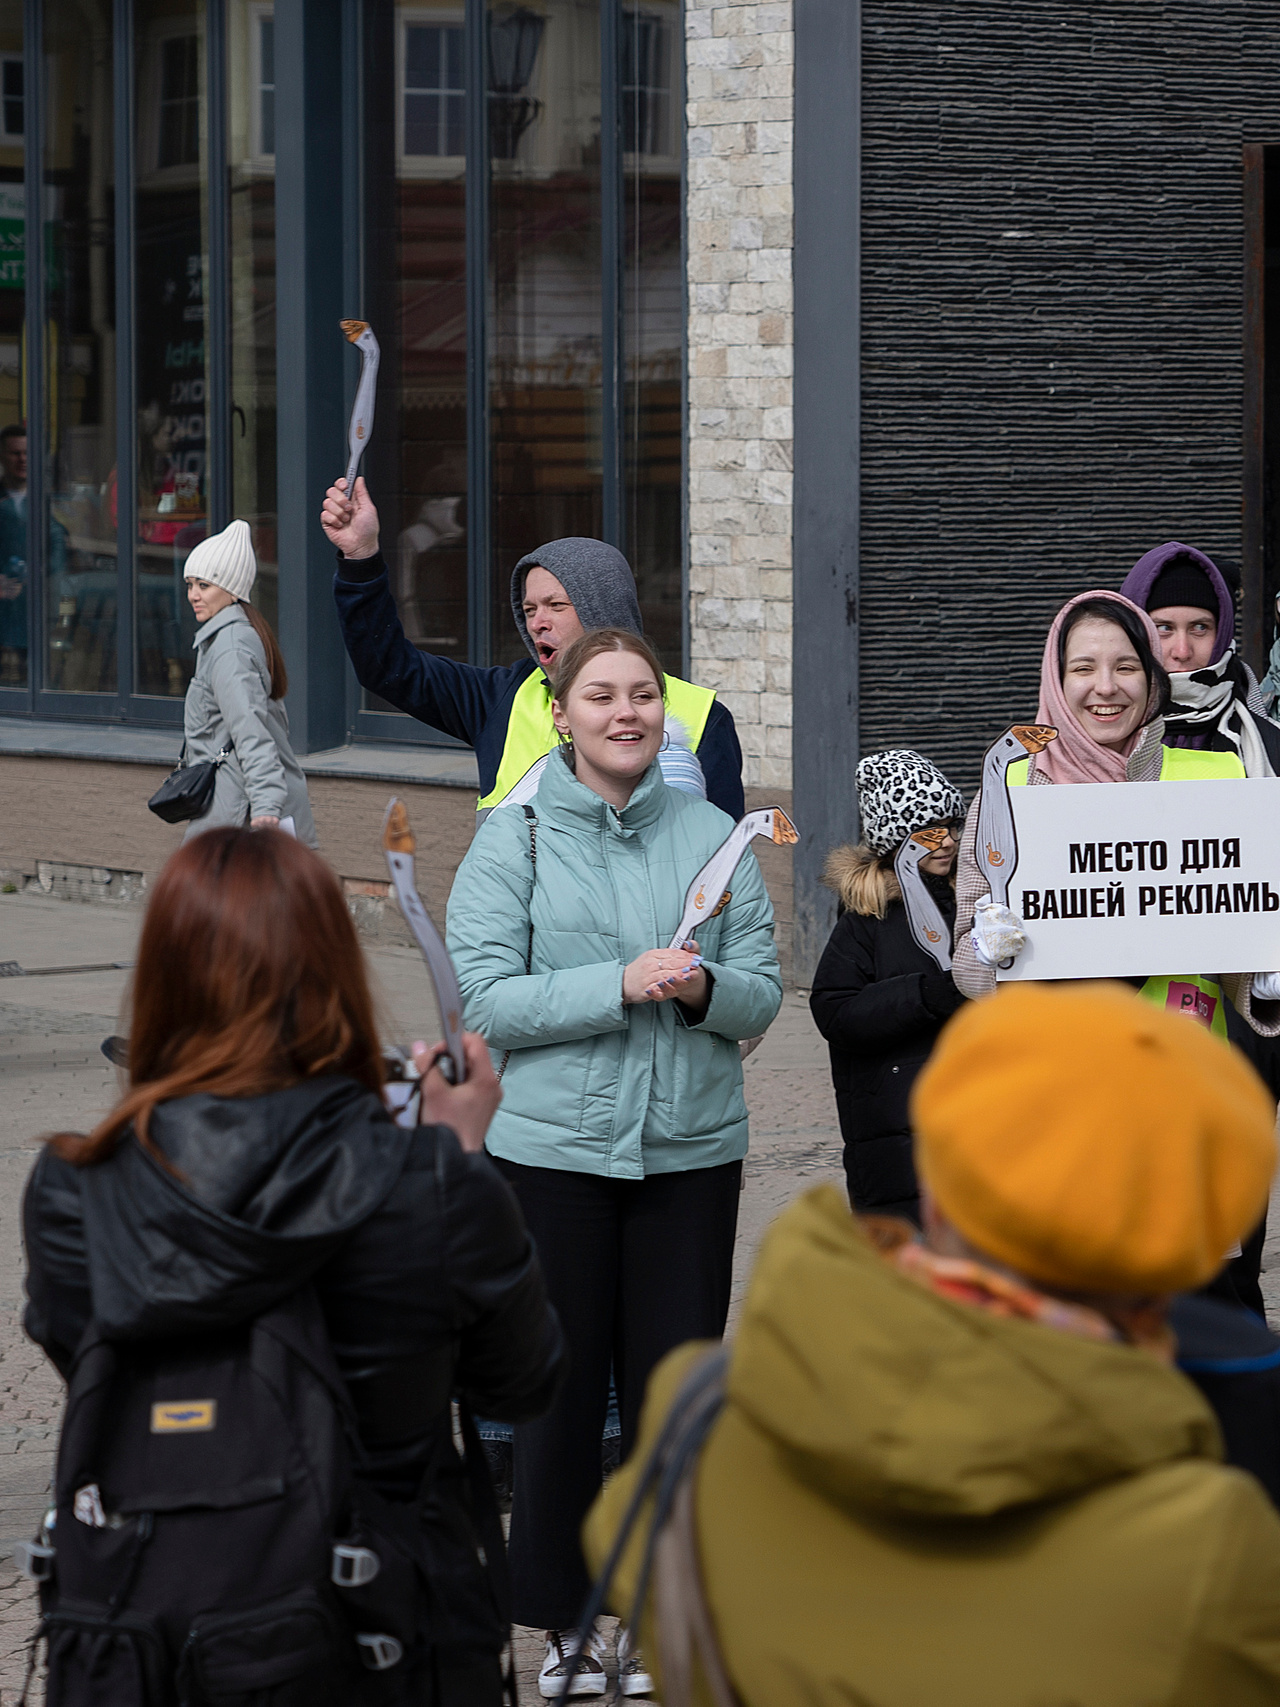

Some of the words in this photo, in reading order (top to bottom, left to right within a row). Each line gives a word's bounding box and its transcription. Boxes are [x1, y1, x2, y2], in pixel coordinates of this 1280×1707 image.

[1069, 840, 1168, 874] МЕСТО
[1180, 838, 1241, 875] ДЛЯ
[1022, 881, 1125, 921] ВАШЕЙ
